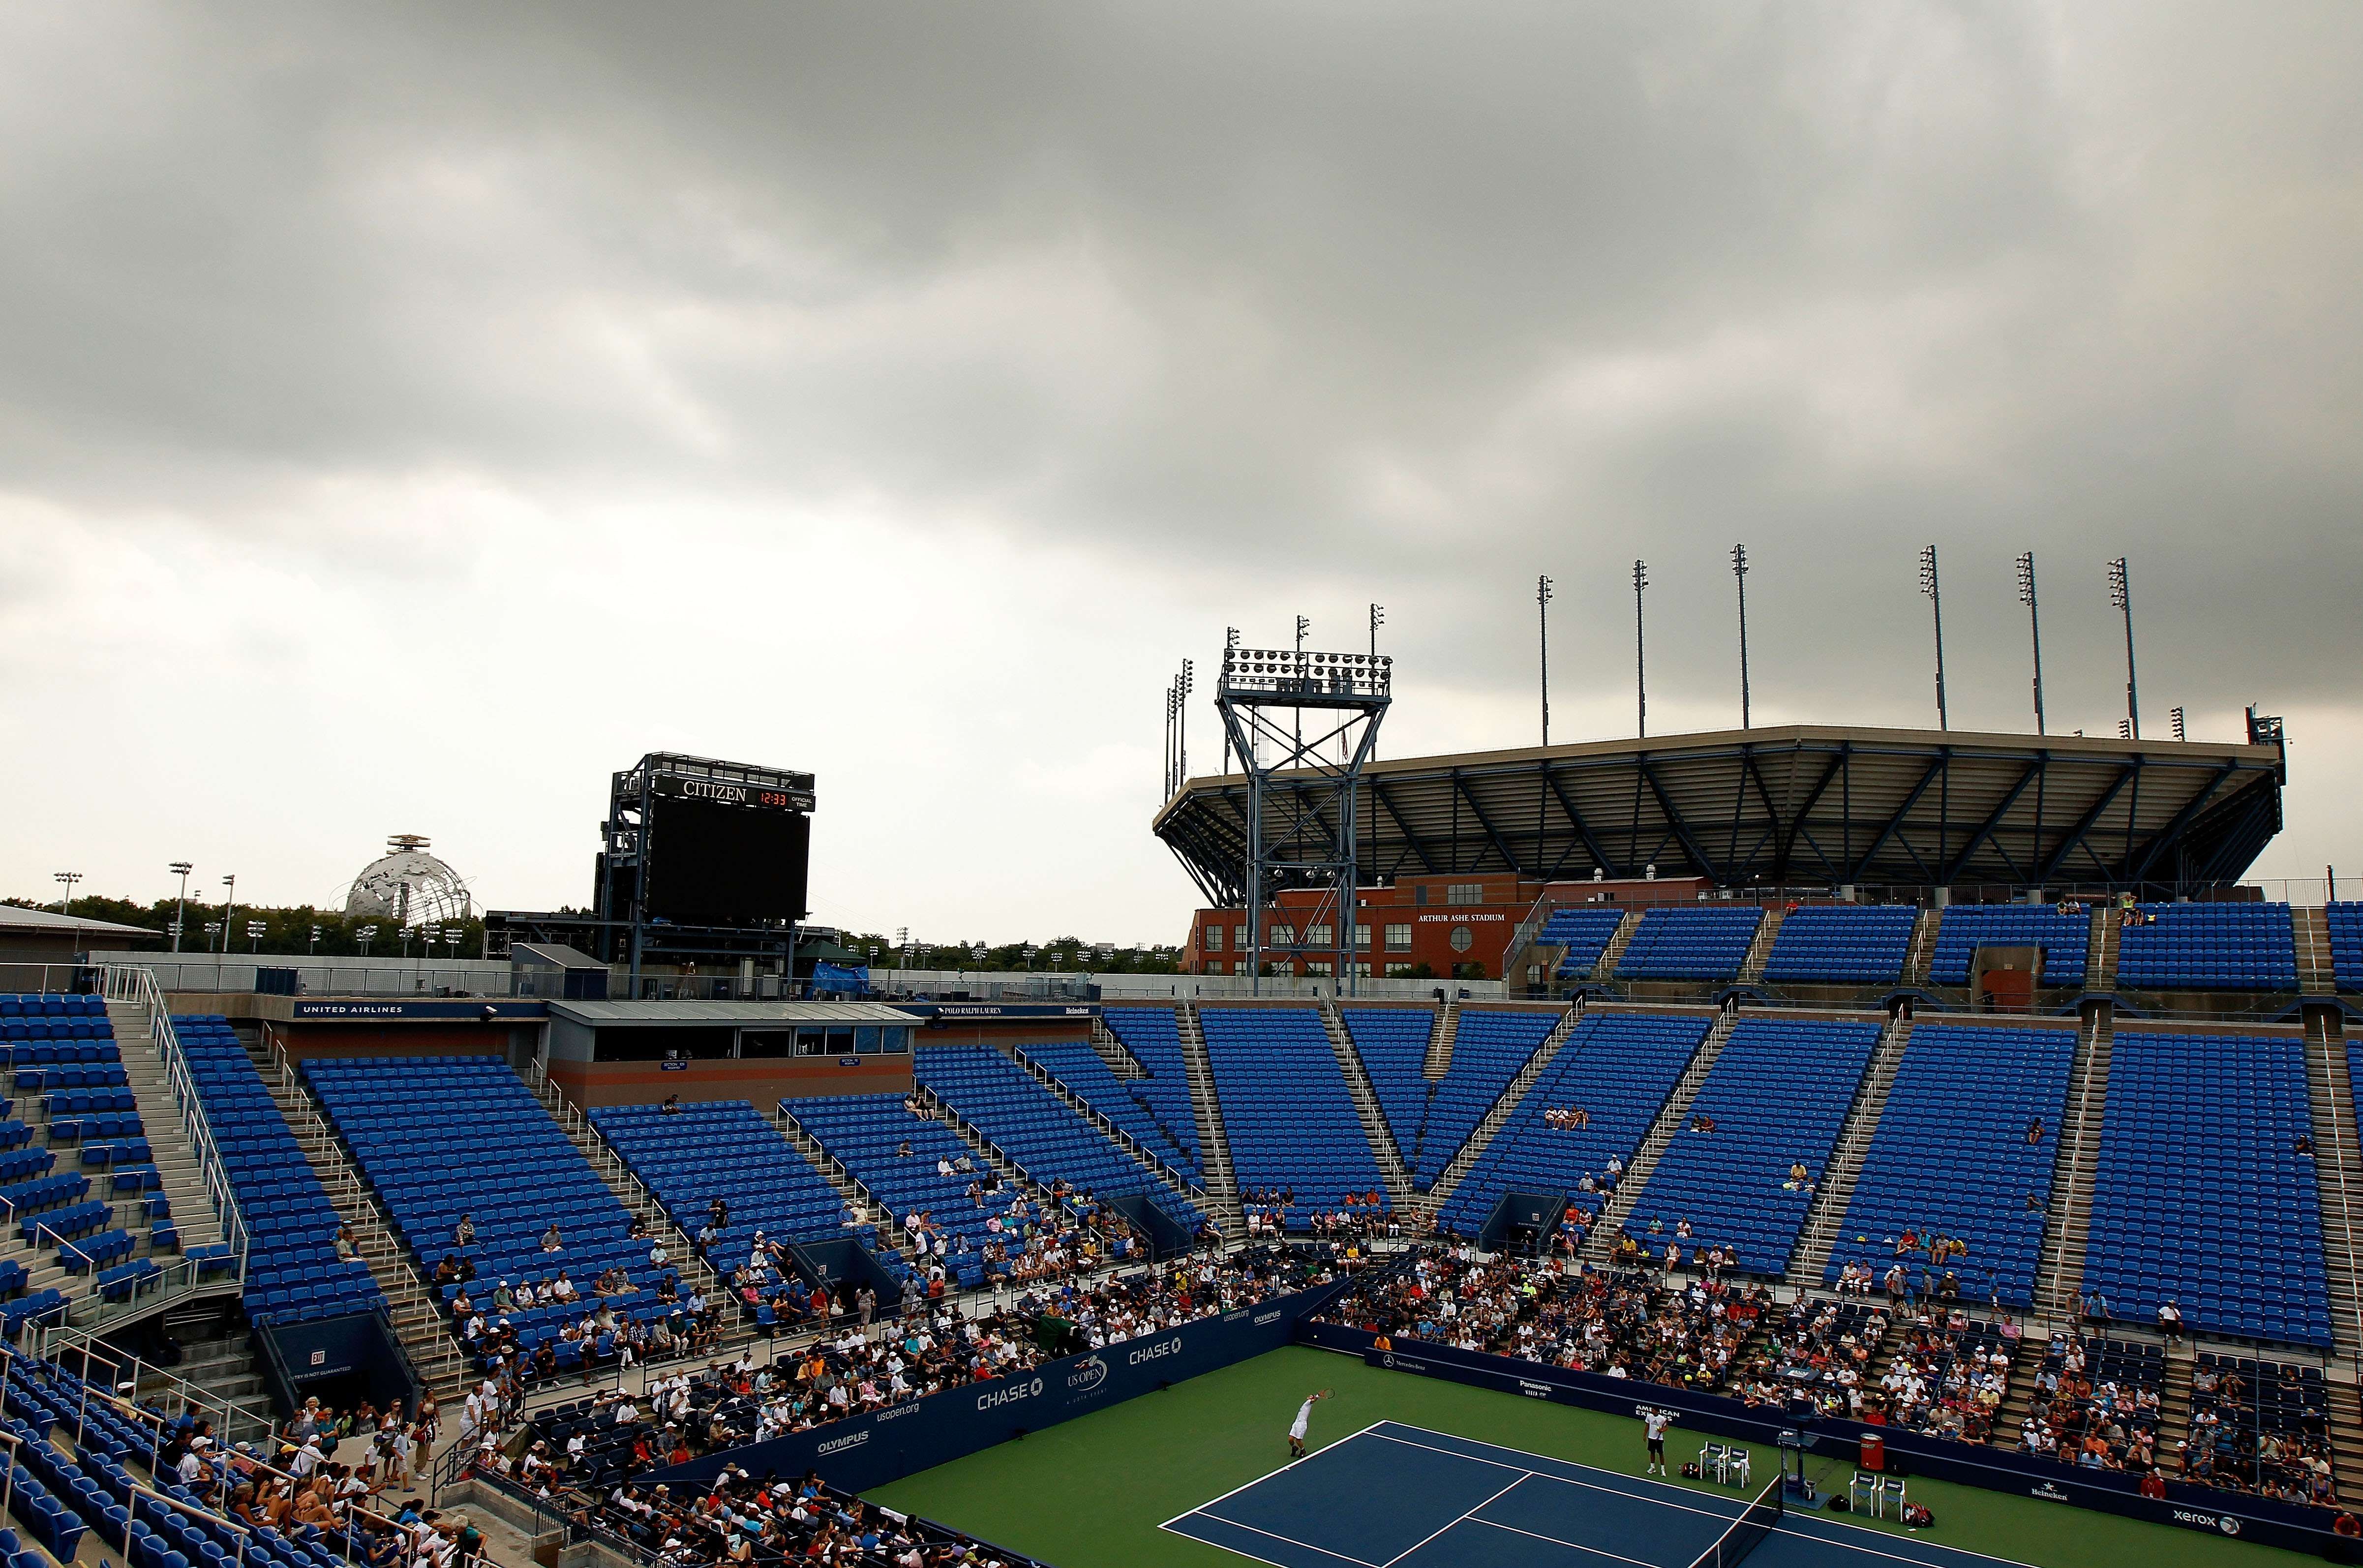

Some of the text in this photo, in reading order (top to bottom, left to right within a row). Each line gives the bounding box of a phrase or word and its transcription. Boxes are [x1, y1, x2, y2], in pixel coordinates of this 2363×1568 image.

[683, 781, 747, 802] CITIZEN
[761, 792, 786, 805] 12:33
[1224, 1309, 1249, 1322] usopen.org
[1254, 1310, 1281, 1323] OLYMPUS
[313, 1352, 324, 1363] EXIT
[1129, 1341, 1170, 1365] CHASE
[320, 1366, 351, 1376] GUARANTEED
[1068, 1367, 1102, 1387] US OPEN
[1519, 1380, 1552, 1391] Panasonic
[977, 1383, 1028, 1411] CHASE
[877, 1403, 919, 1422] usopen.org
[1636, 1405, 1680, 1417] AMEICAN
[818, 1430, 869, 1453] OLYMPUS
[2031, 1488, 2068, 1501] Heineken
[2173, 1510, 2216, 1527] xerox
